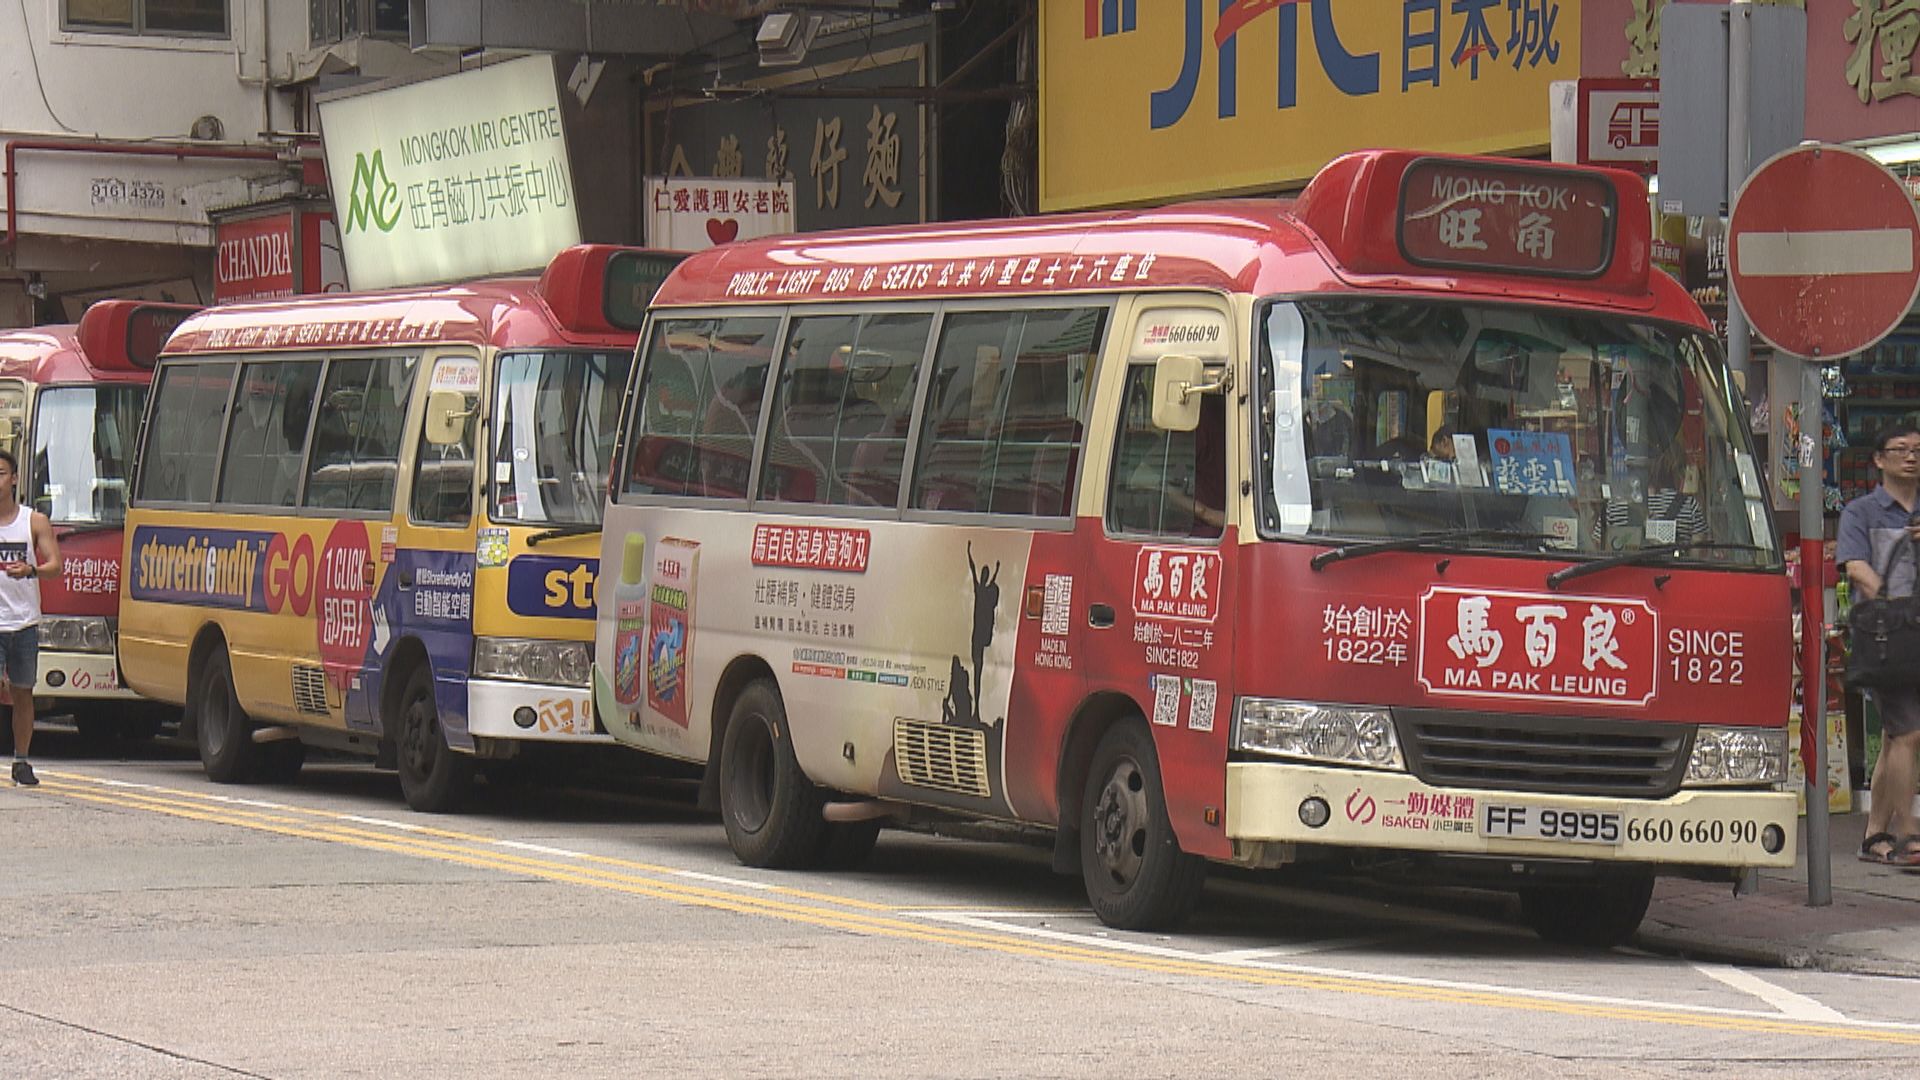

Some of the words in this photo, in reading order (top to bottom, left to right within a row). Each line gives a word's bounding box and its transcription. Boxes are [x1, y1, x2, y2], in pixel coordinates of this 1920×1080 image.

[1402, 0, 1561, 93] 日本城
[400, 126, 471, 167] MONGKOK
[470, 119, 498, 153] MRI
[500, 106, 560, 147] CENTRE
[407, 156, 570, 231] 旺角磁力共振中心
[654, 187, 790, 214] 仁愛護理安老院
[1432, 175, 1505, 205] MONG
[1519, 184, 1568, 211] KOK
[218, 231, 292, 284] CHANDRA
[726, 271, 774, 296] PUBLIC
[777, 269, 821, 294] LIGHT
[822, 267, 855, 293] BUS
[858, 266, 877, 291] 16
[882, 264, 932, 290] SEATS
[1168, 325, 1187, 343] 660
[1187, 325, 1206, 343] 660
[1206, 325, 1220, 342] 90
[63, 557, 120, 578] 始創於
[334, 547, 366, 592] CLICK
[64, 577, 117, 595] 1822年
[1141, 599, 1154, 612] MA
[1157, 600, 1174, 614] PAK
[1178, 602, 1207, 617] LEUNG
[1322, 604, 1412, 639] 始創於
[1041, 638, 1060, 653] MADE
[1133, 621, 1214, 651] 始創於一八二二年
[1667, 628, 1743, 658] SINCE
[1034, 652, 1053, 668] HONG
[1054, 654, 1072, 670] KONG
[1323, 637, 1408, 667] 1822年
[927, 677, 945, 692] STYLE
[1444, 668, 1482, 688] MA
[1492, 671, 1541, 692] PAK
[1551, 674, 1628, 697] LEUNG
[1670, 657, 1743, 686] 1822
[1383, 791, 1475, 820] 一勤媒體
[1382, 814, 1429, 831] ISAKEN
[1486, 806, 1527, 835] FF
[1540, 809, 1619, 841] 9995
[1627, 818, 1673, 842] 660
[1679, 819, 1723, 843] 660
[1730, 819, 1758, 844] 90
